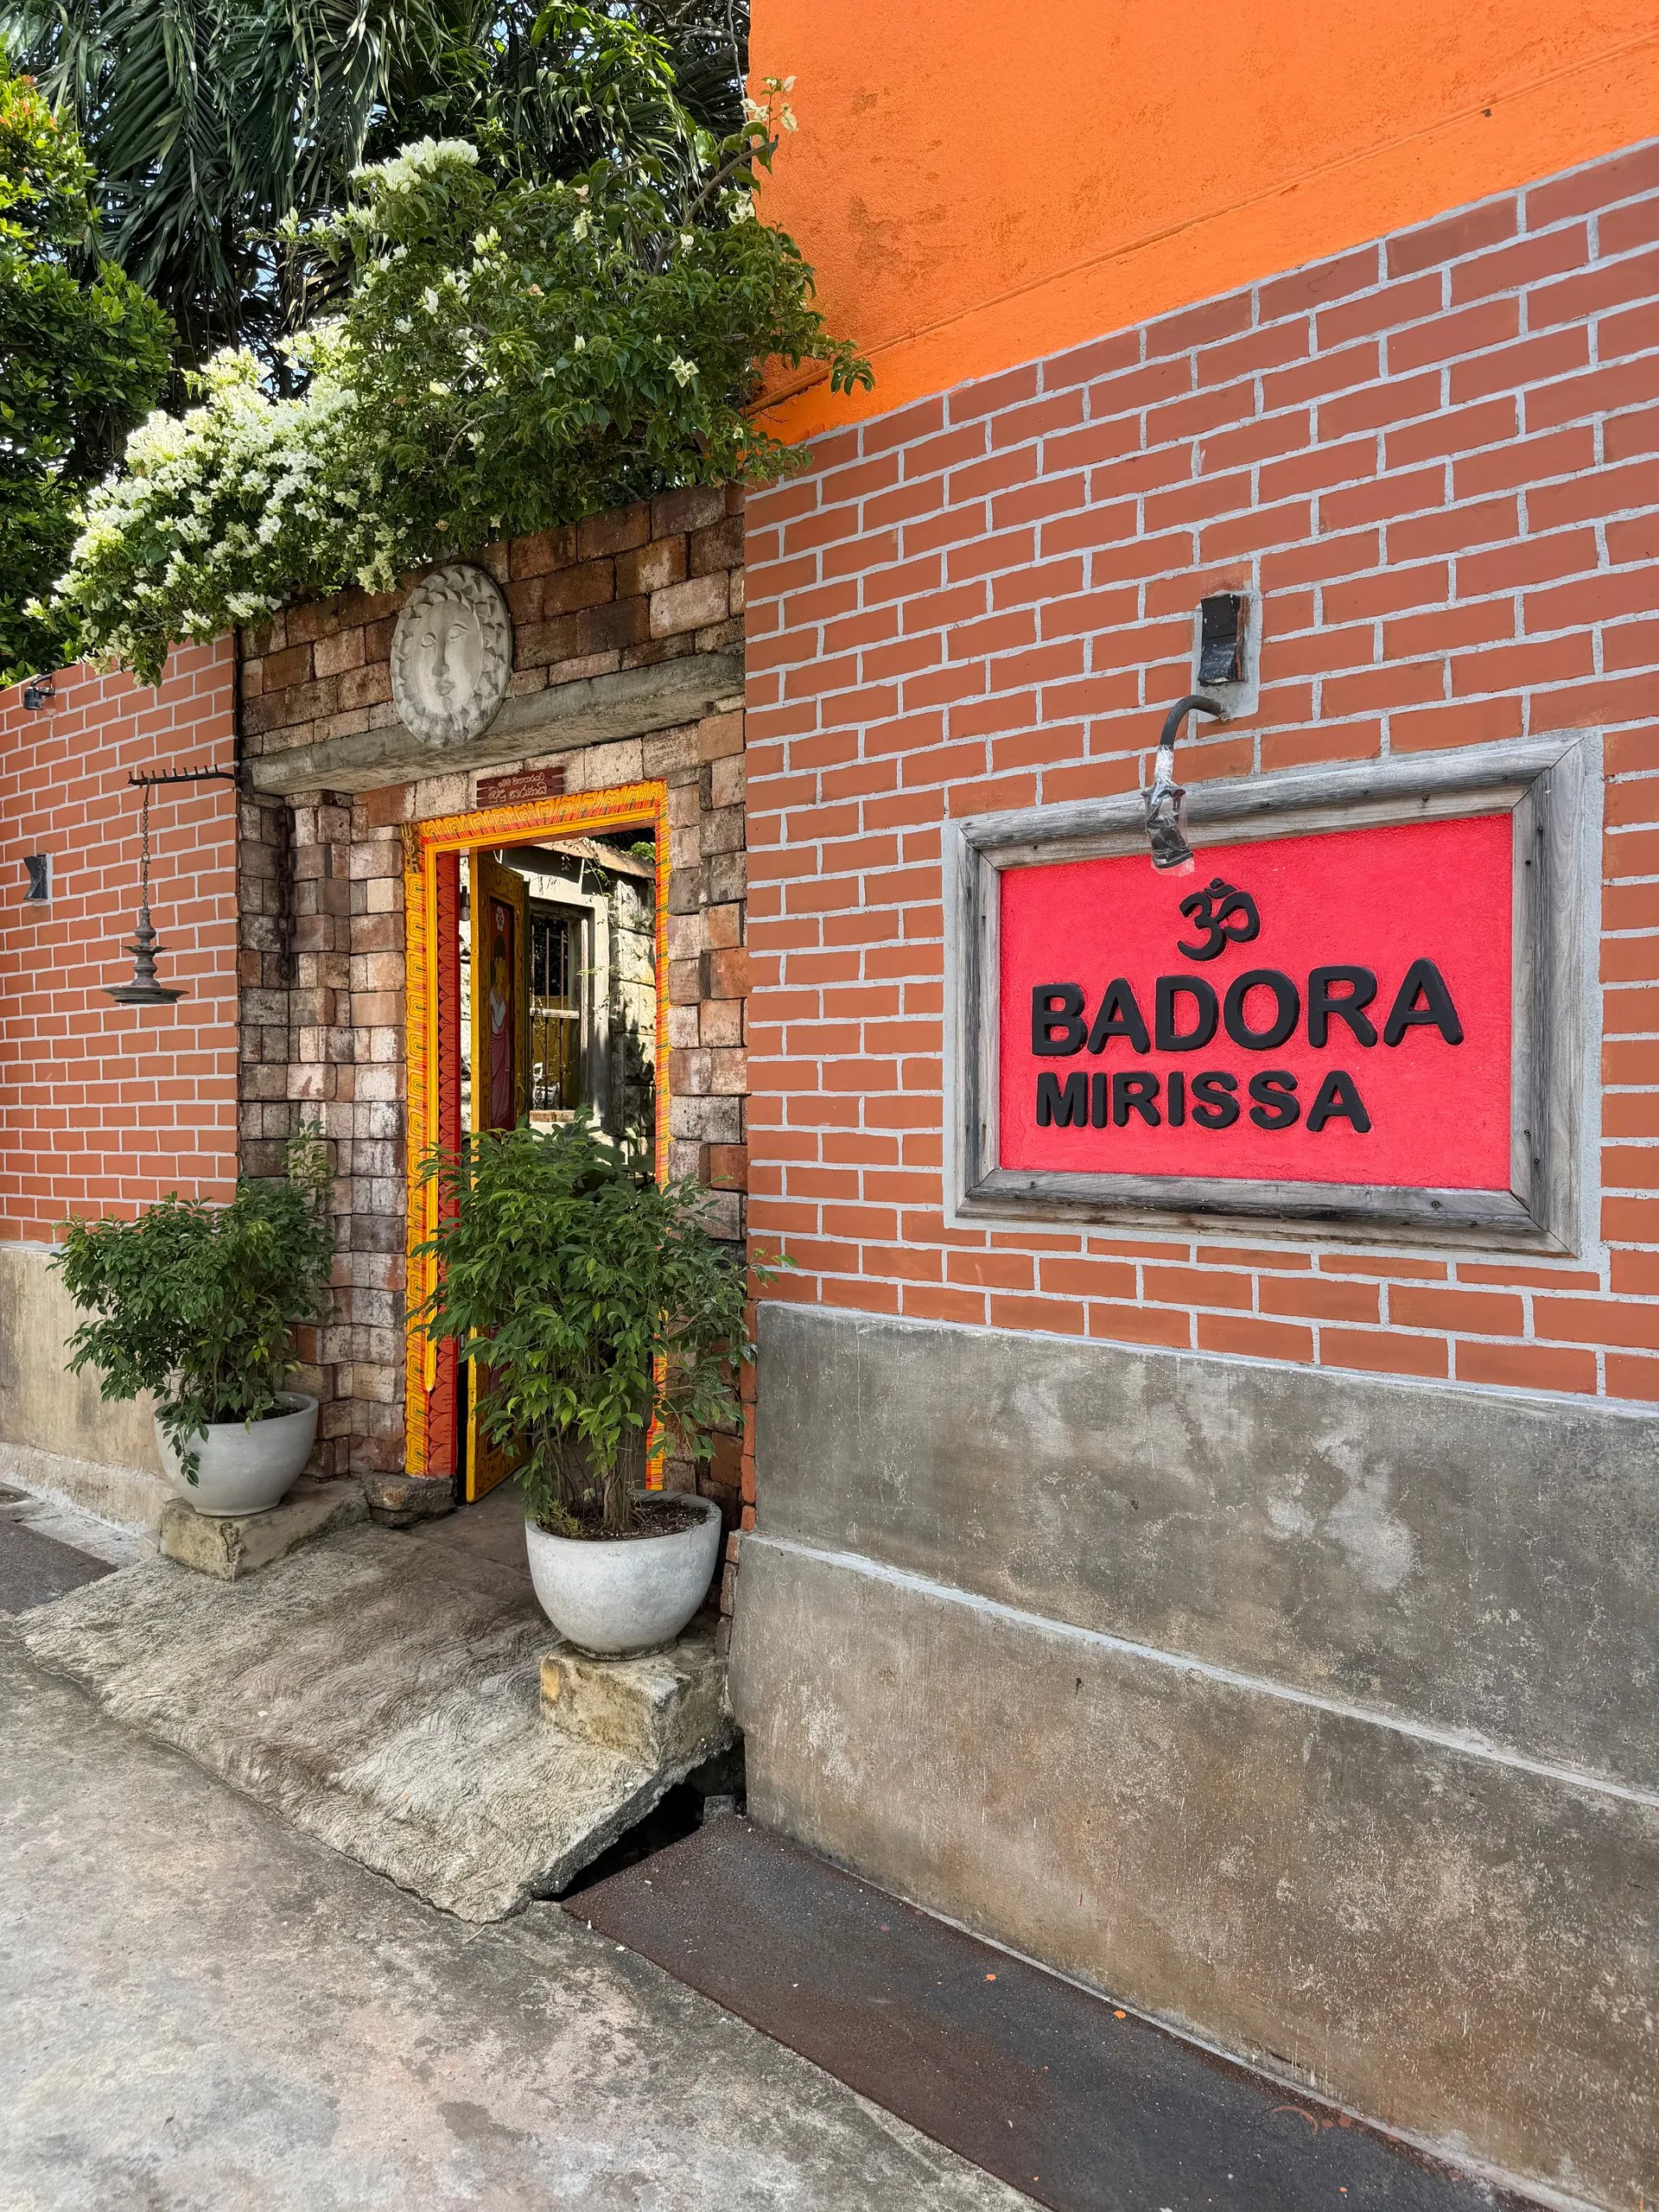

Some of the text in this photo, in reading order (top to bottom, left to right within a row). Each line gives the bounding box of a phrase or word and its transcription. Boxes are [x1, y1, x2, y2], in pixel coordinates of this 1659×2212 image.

[487, 781, 548, 804] බුදු සරණයි
[1032, 957, 1465, 1057] BADORA
[1036, 1069, 1372, 1134] MIRISSA
